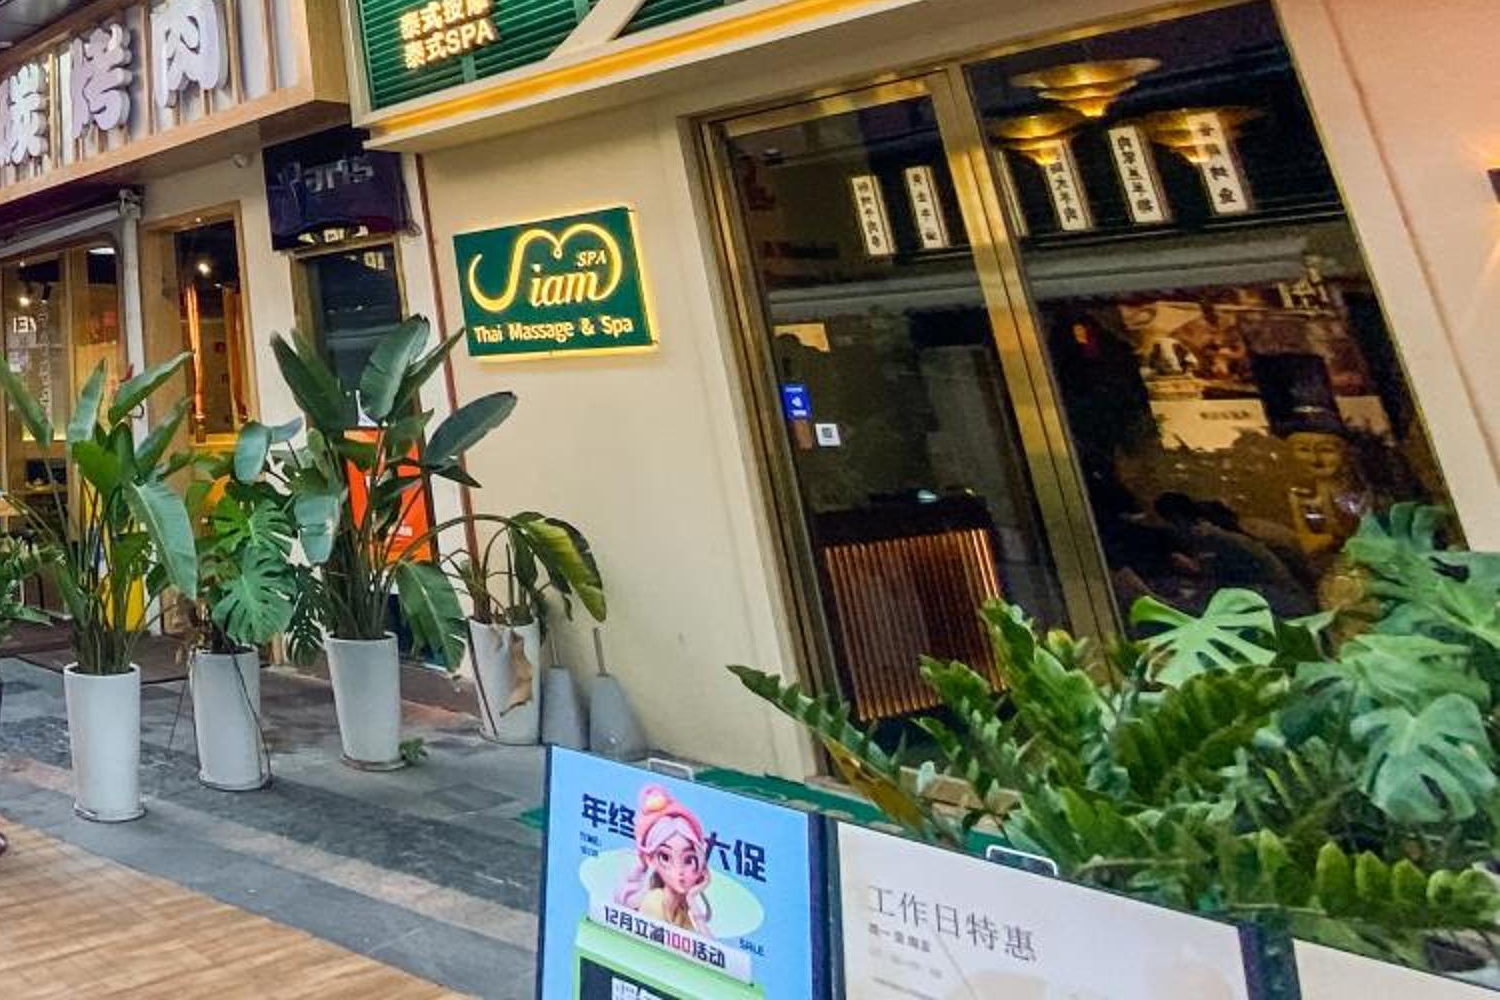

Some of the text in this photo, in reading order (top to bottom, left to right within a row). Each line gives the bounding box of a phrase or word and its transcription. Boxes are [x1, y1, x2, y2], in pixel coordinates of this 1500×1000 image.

[403, 18, 497, 69] 泰式SPA
[469, 223, 623, 313] Siam
[577, 249, 607, 267] SPA
[474, 315, 635, 344] Thai Massage & Spa
[581, 793, 767, 883] 年终 大促
[603, 905, 726, 969] 12月立减100活动
[867, 884, 1038, 962] 工作日特惠
